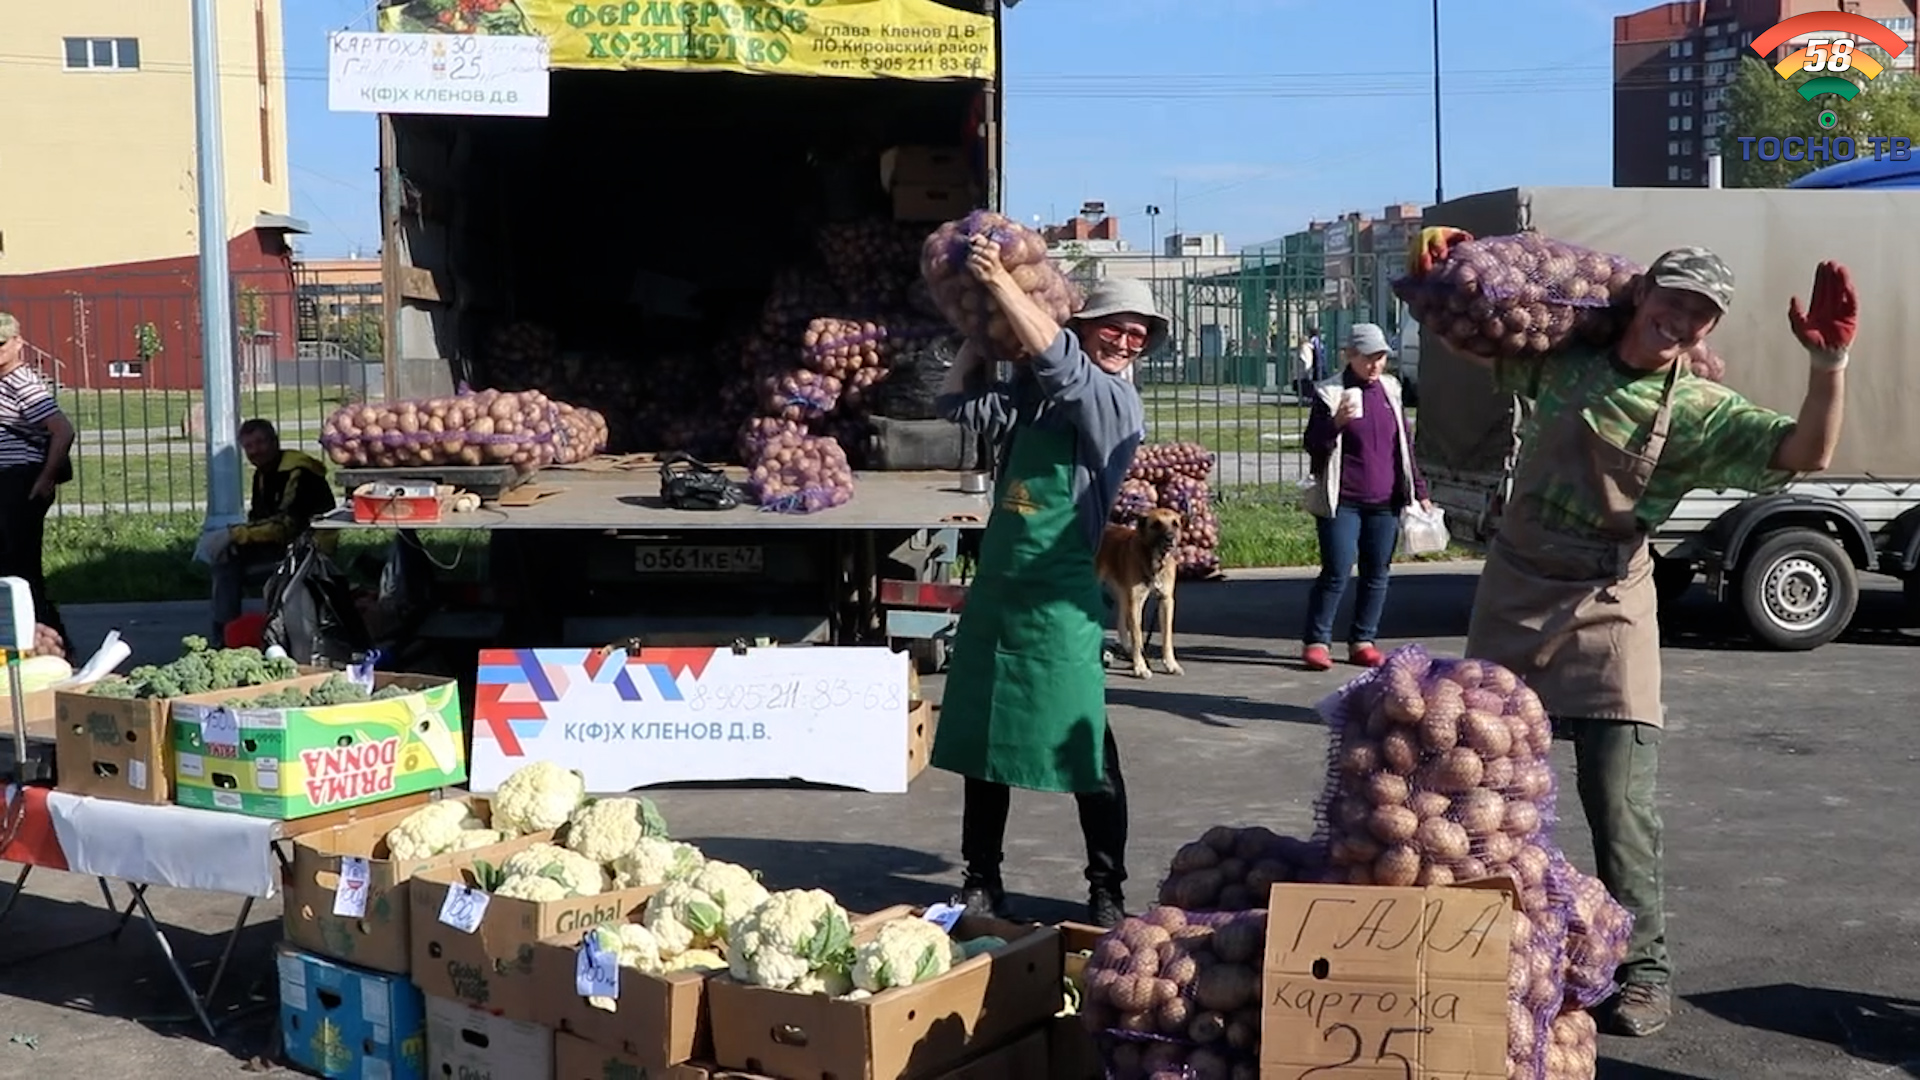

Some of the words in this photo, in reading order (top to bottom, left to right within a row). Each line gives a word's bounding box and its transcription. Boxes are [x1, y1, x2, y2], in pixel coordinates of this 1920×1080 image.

[823, 25, 870, 38] глава
[881, 23, 942, 38] Кленов
[946, 25, 980, 39] Д.В.
[334, 36, 429, 56] КАРТОХА
[938, 40, 989, 55] район
[823, 59, 855, 70] тел.
[860, 58, 869, 71] 8
[874, 58, 903, 71] 905
[907, 58, 934, 71] 211
[939, 58, 959, 71] 83
[360, 87, 409, 101] К(Ф)Х
[414, 88, 485, 102] КЛЕНОВ
[564, 721, 625, 743] К(Ф)Х
[631, 722, 723, 742] КЛЕНОВ
[727, 722, 772, 742] Д.В.
[302, 739, 398, 777] DONNA
[306, 766, 394, 805] PRIMA
[556, 899, 622, 934] Global
[1291, 898, 1504, 958] ГАЛА
[1298, 1022, 1434, 1080] 25
